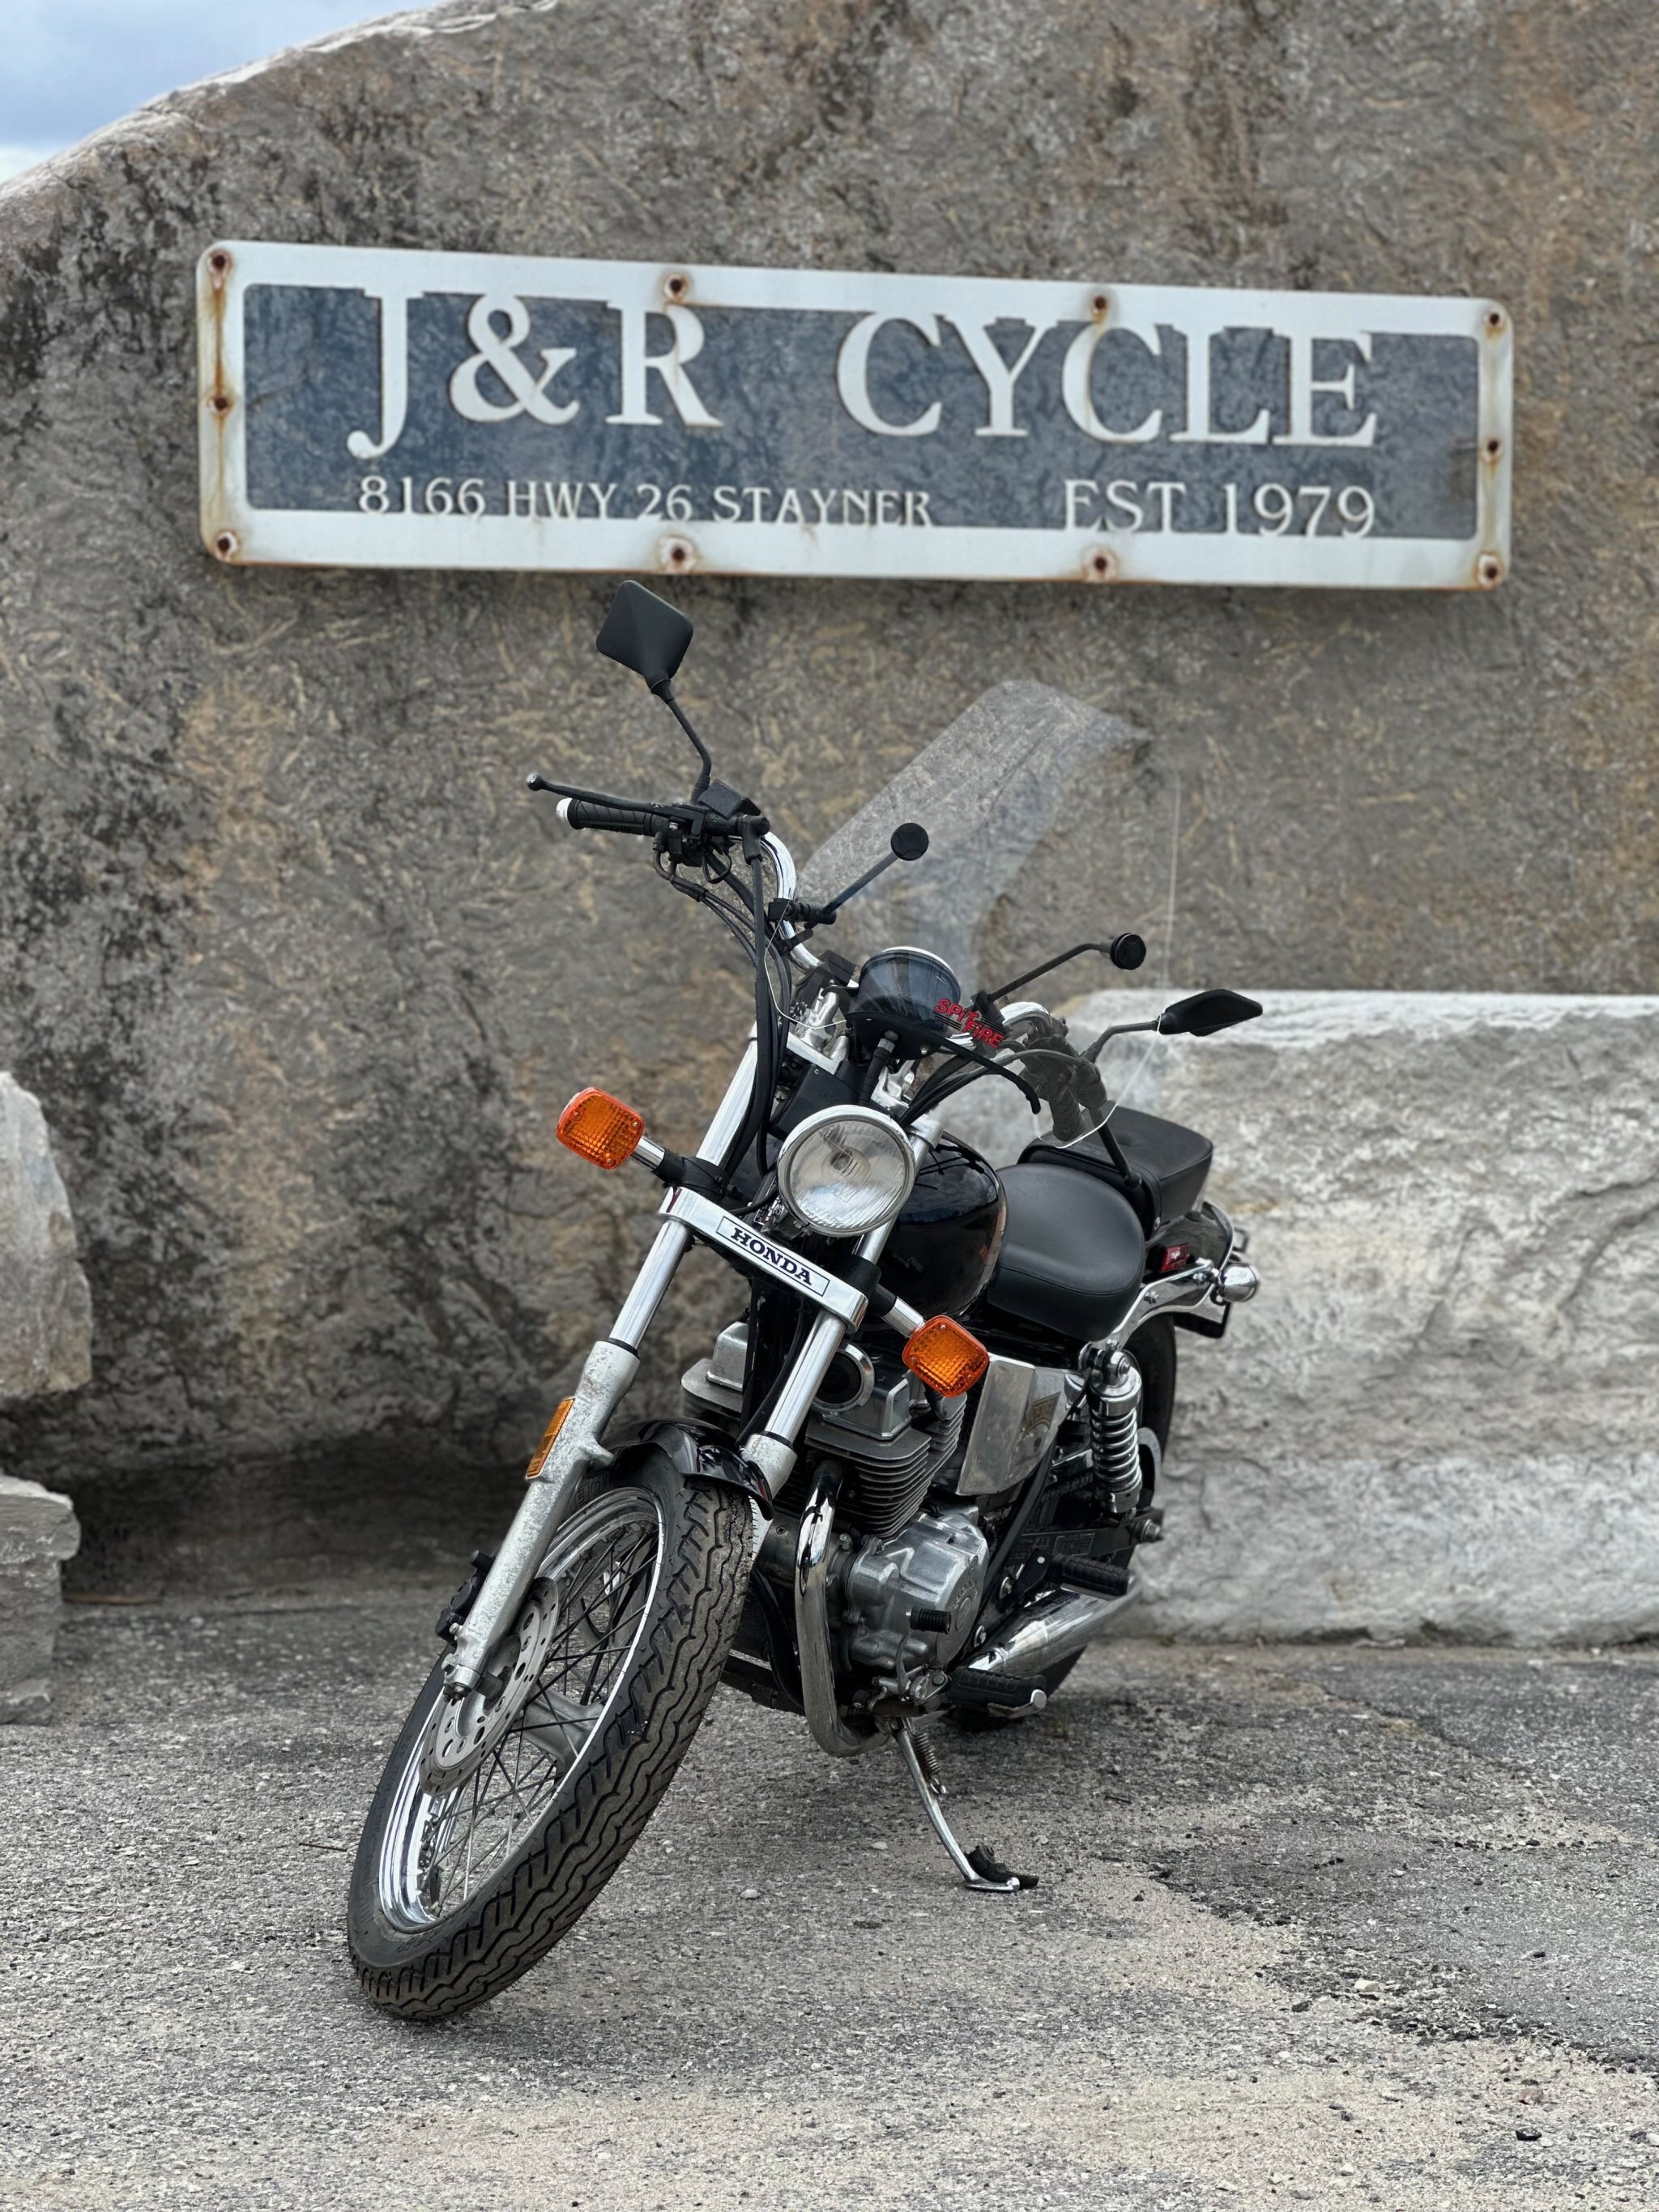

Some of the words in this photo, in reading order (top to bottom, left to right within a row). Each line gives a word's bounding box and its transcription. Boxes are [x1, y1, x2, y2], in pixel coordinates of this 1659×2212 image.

[837, 310, 1376, 447] CYCLE
[359, 475, 486, 516] 8166
[507, 480, 617, 519] HWY
[637, 484, 693, 520] 26
[711, 486, 932, 526] STAYNER
[1064, 479, 1187, 532] EST
[1223, 483, 1376, 537] 1979
[731, 1227, 812, 1286] HONDA
